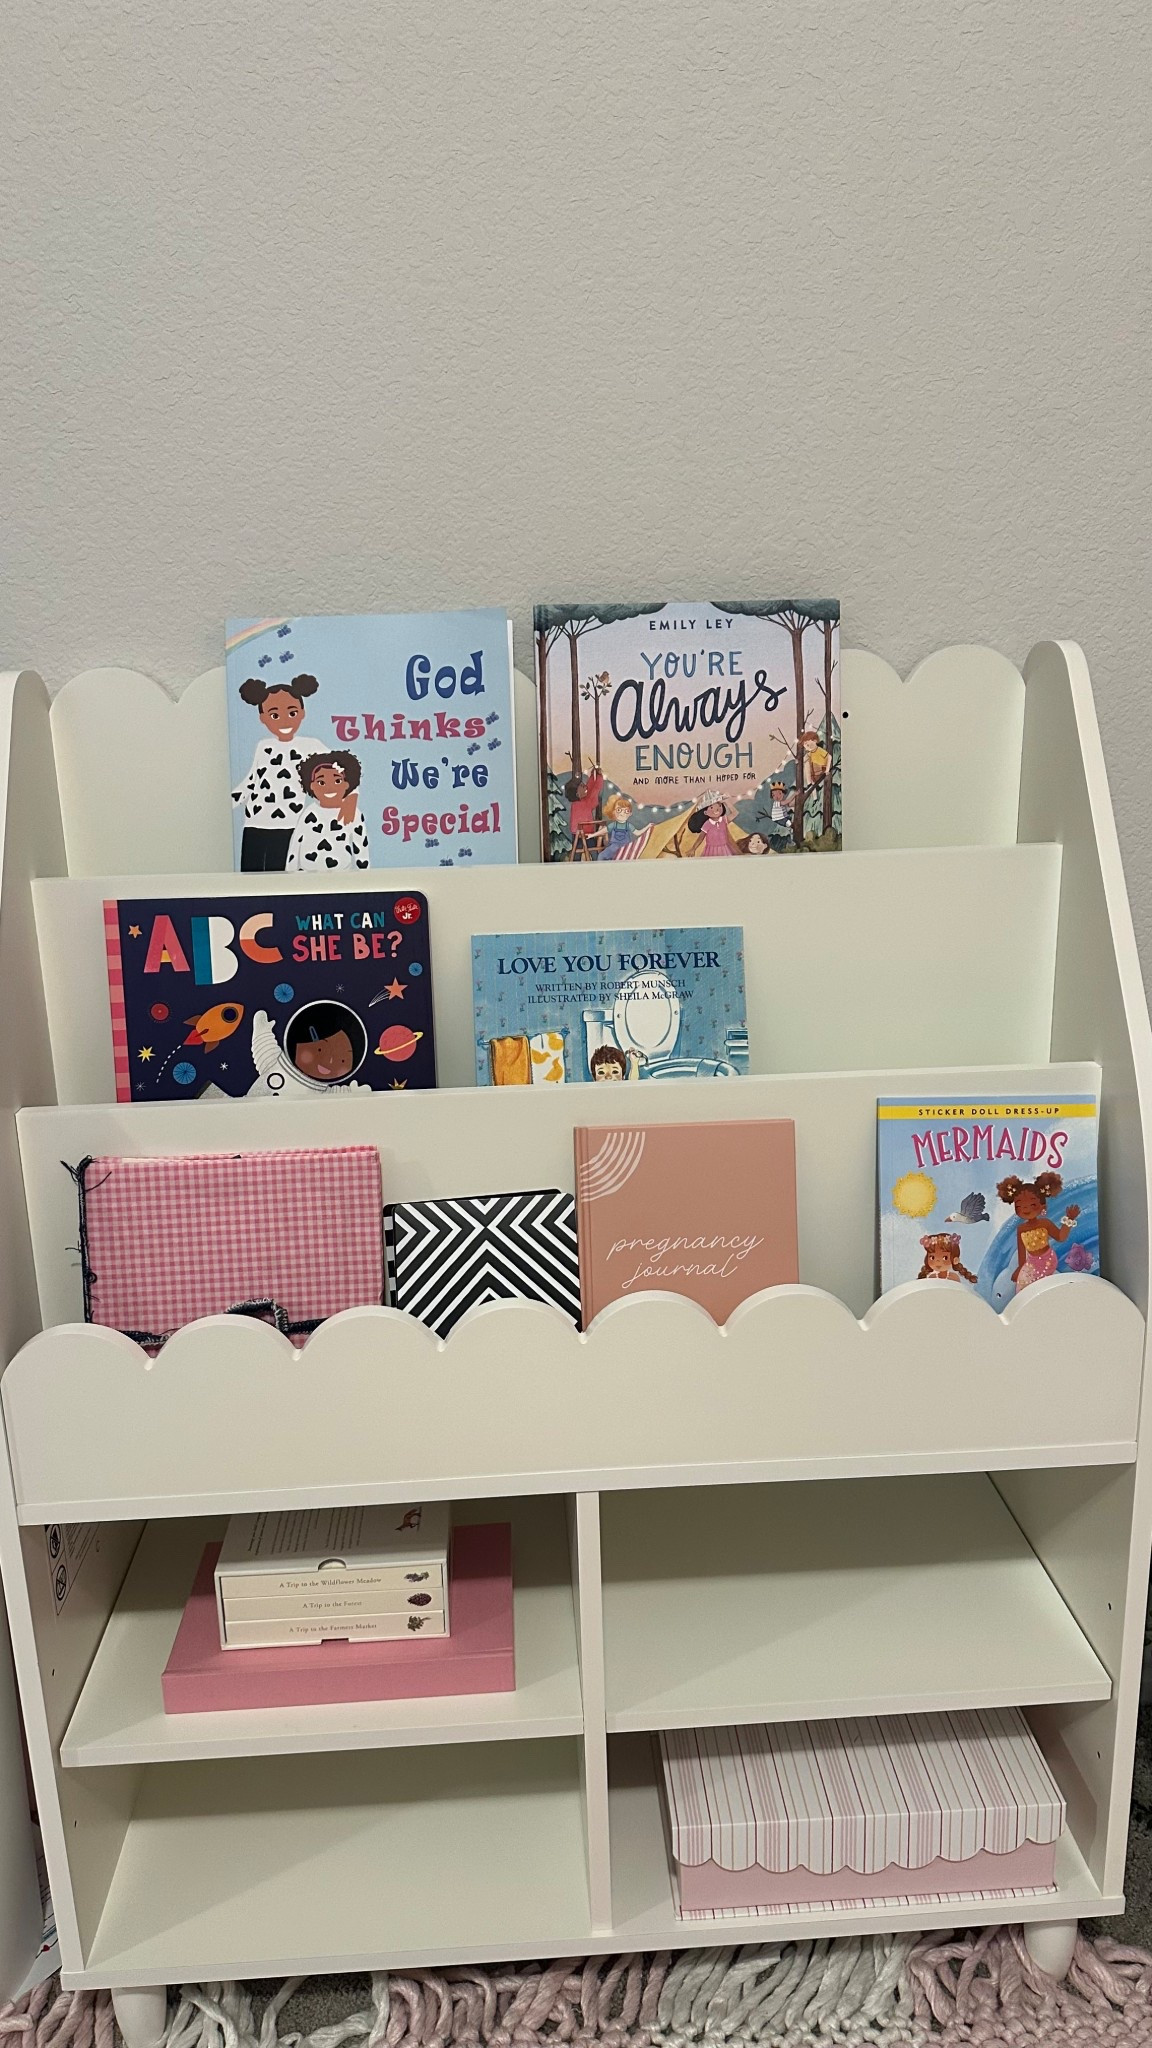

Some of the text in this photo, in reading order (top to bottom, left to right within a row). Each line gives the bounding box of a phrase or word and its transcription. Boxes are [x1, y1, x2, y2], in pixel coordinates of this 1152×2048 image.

[649, 618, 734, 631] EMILY LEY
[406, 650, 485, 700] God
[640, 649, 743, 680] YOU'RE
[331, 711, 486, 742] Thinks
[635, 741, 753, 771] ENOUGH
[391, 756, 489, 789] We're
[633, 777, 649, 785] AND
[654, 776, 679, 785] MORE
[683, 775, 706, 784] THAN
[716, 773, 739, 782] HOPED
[743, 772, 756, 780] FOR
[381, 802, 501, 842] Special
[295, 911, 385, 931] WHAT CAN
[143, 912, 284, 986] ABC
[292, 930, 403, 963] SHE BE?
[498, 951, 721, 975] LOVE YOU FOREVER
[527, 990, 694, 1004] ILLUSTRATED BY SHEILA McGRAW
[535, 979, 686, 992] WRITTEN BY ROBERT MUNSCH
[918, 1108, 965, 1116] STICKER
[1005, 1107, 1060, 1115] DRESS-UP
[911, 1124, 1069, 1169] MERMAIDS
[606, 1232, 764, 1263] pregnancy
[621, 1253, 738, 1289] journal
[286, 1581, 300, 1589] Trip
